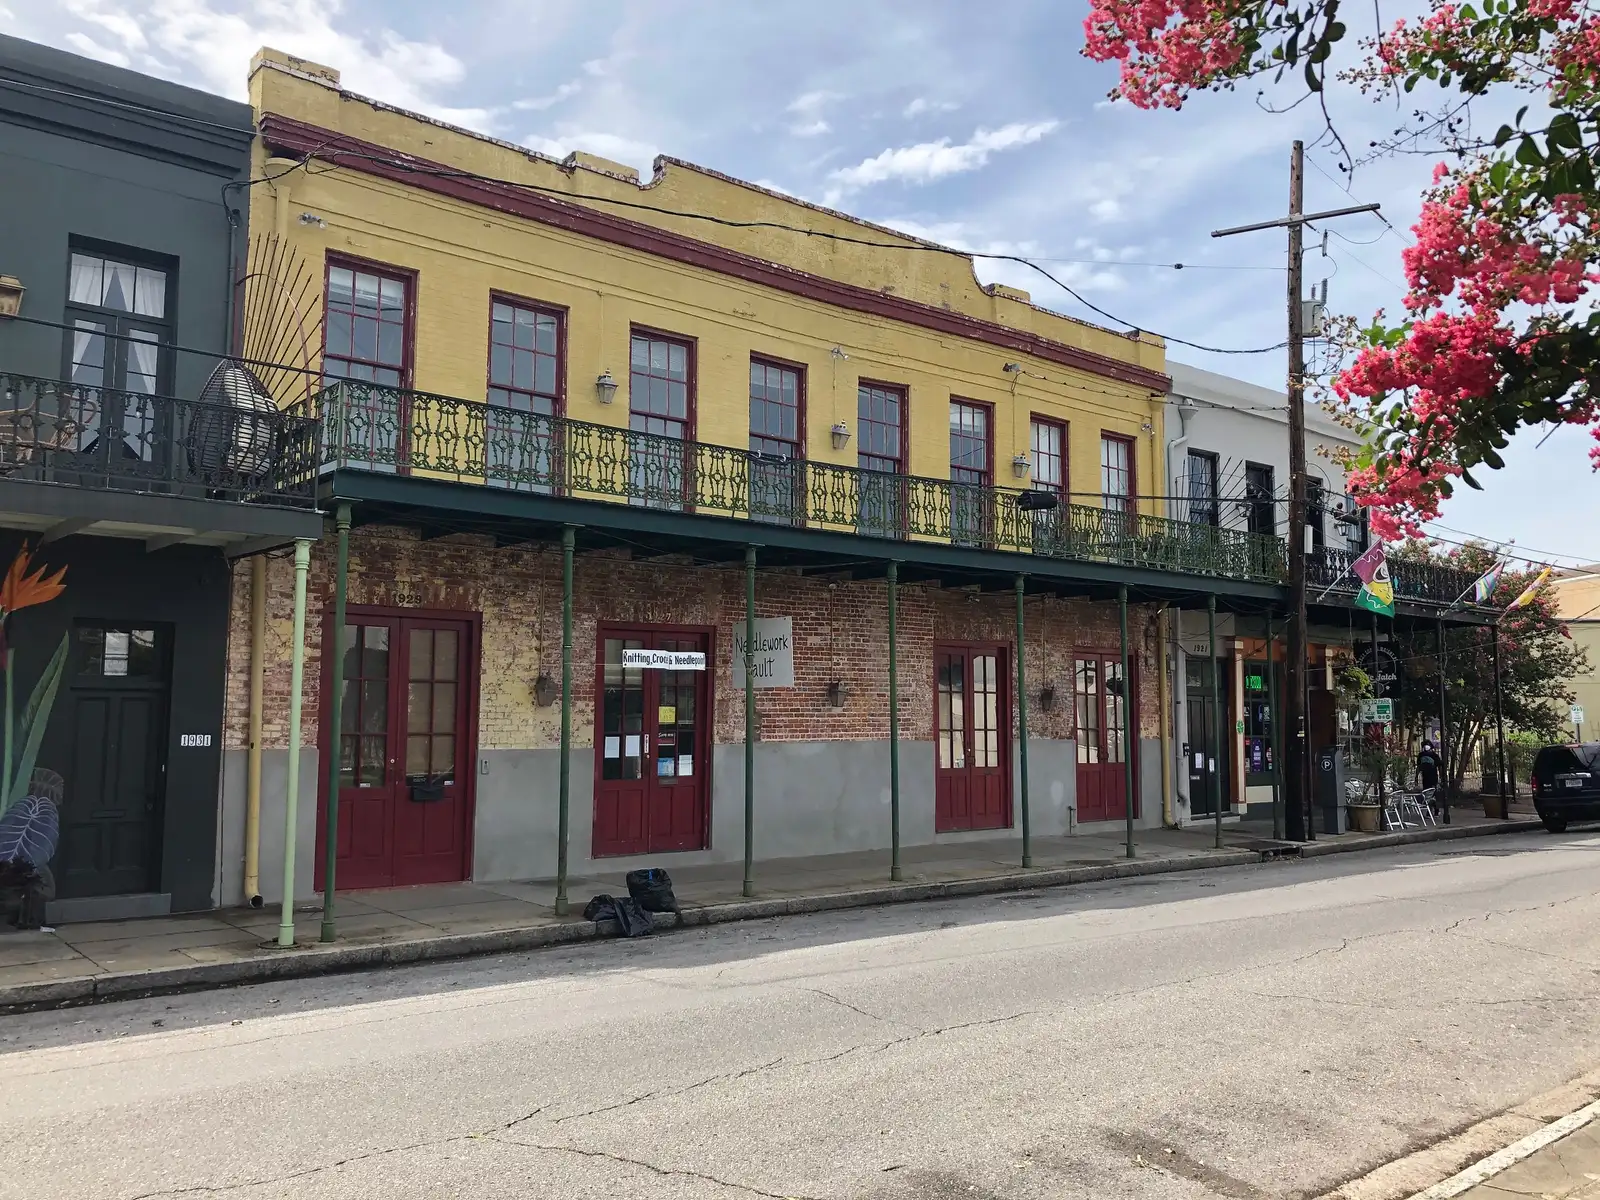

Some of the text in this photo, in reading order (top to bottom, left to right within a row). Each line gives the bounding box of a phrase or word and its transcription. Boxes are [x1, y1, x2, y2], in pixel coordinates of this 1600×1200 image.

[392, 593, 421, 604] 1929
[735, 632, 788, 657] Nedlework
[1193, 644, 1208, 653] 1921
[182, 734, 211, 747] 1931
